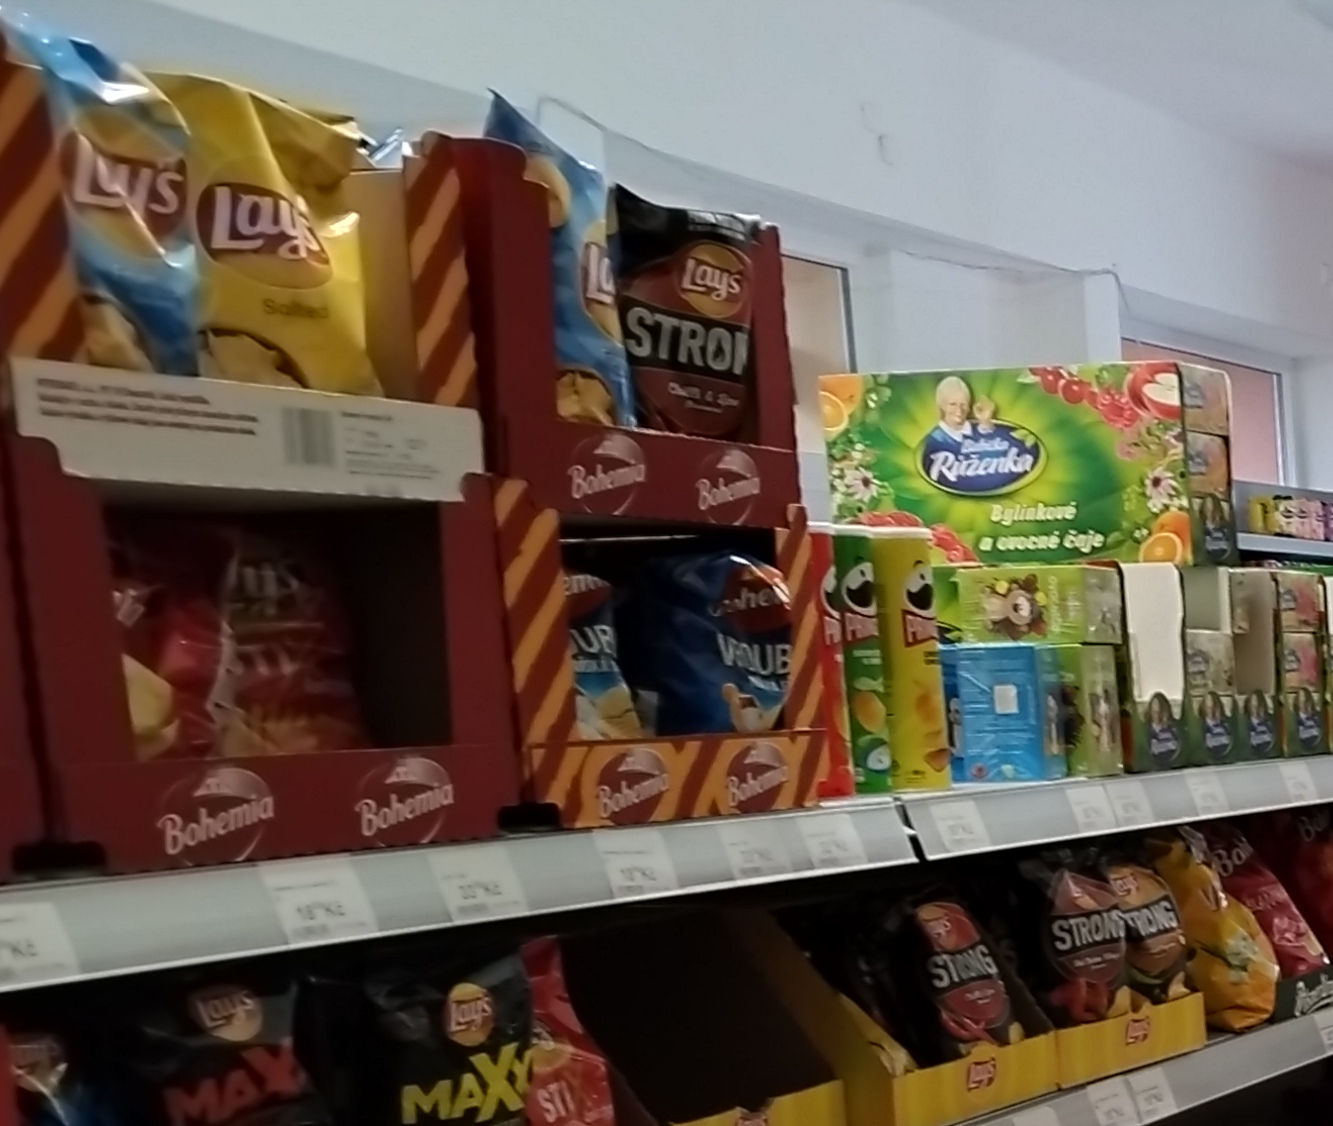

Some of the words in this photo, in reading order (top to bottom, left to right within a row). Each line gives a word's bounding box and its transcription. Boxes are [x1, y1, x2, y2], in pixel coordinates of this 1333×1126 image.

[990, 502, 1077, 526] Bylinkové
[996, 530, 1060, 551] ovocné
[1062, 529, 1105, 554] čaje
[157, 796, 275, 856] Bohemia
[355, 784, 456, 837] Bohemia
[930, 943, 999, 989] STRONG
